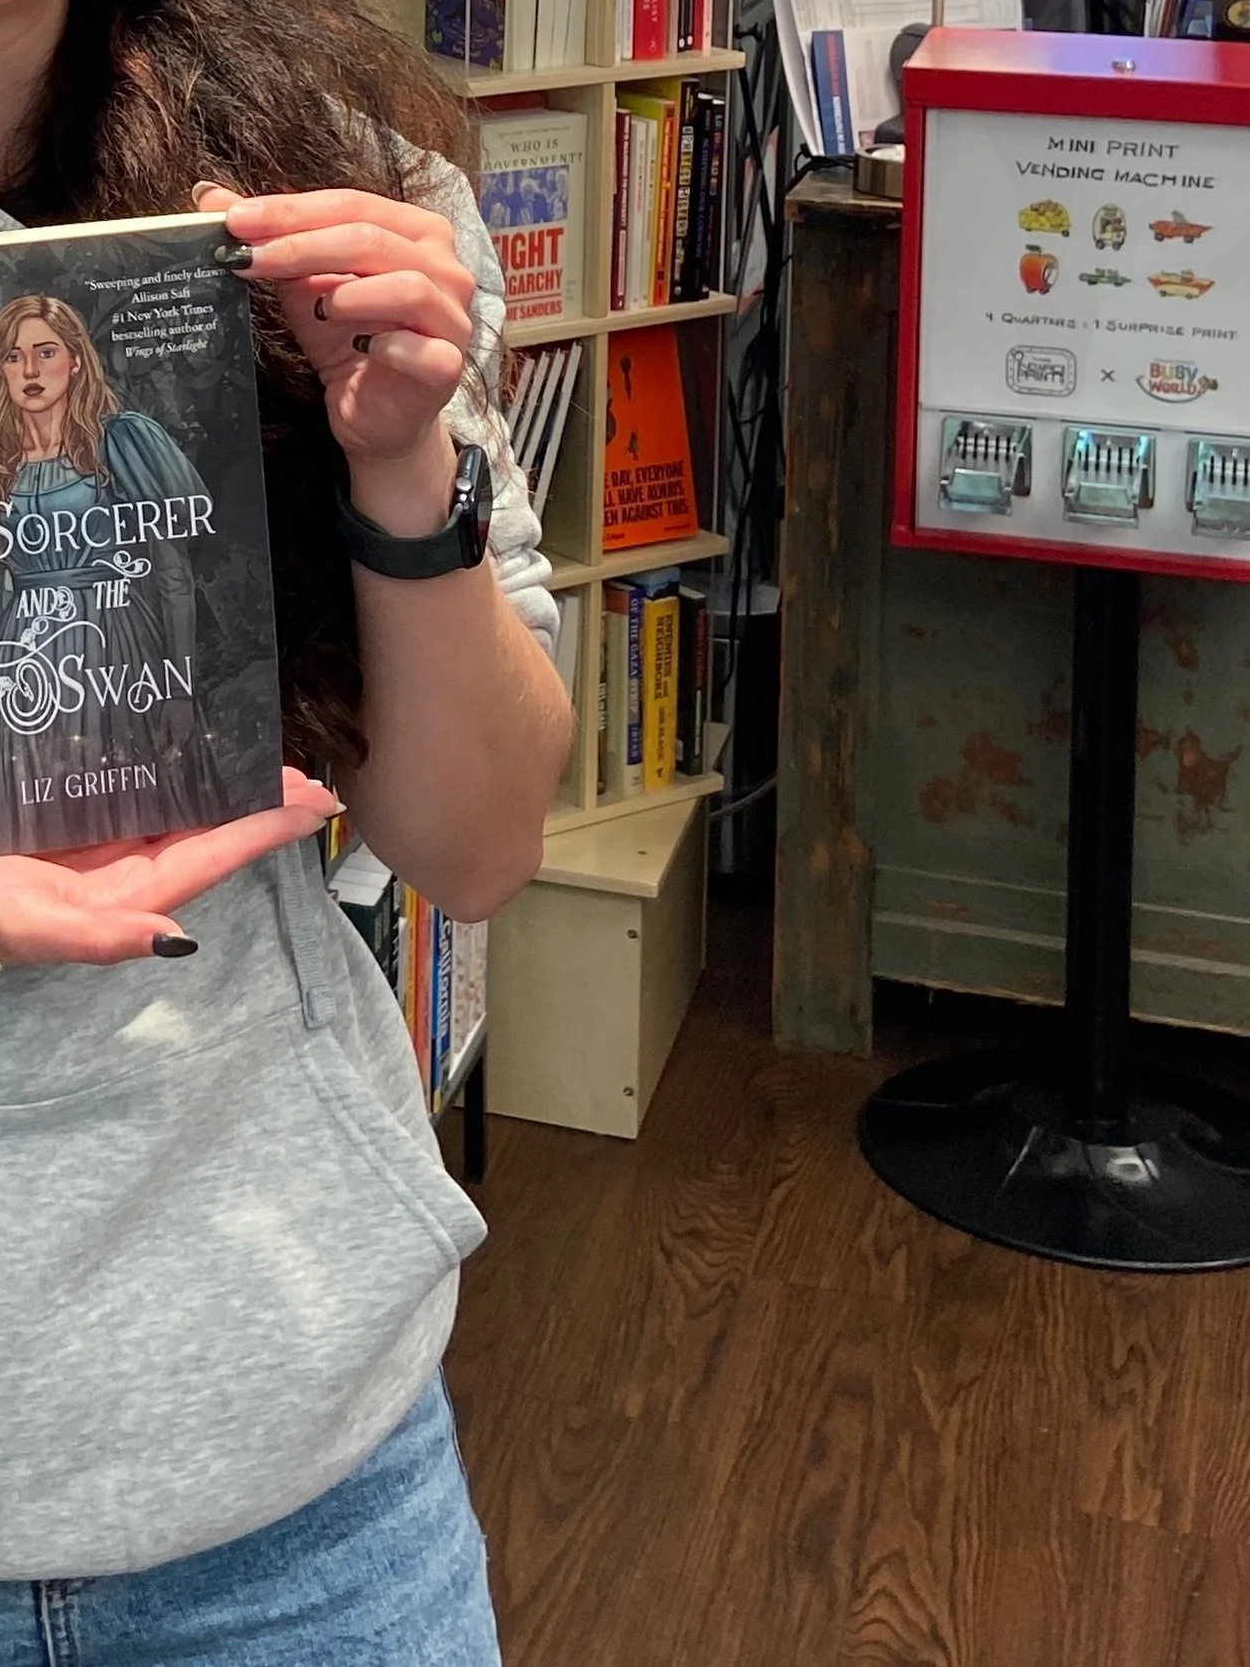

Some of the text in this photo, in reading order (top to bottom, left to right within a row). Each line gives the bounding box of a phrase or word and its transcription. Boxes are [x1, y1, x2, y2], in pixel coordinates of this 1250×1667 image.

[511, 139, 559, 153] WHO IS
[1047, 138, 1180, 159] MINI PRINT
[1016, 161, 1215, 189] VENDING MACHINE
[142, 272, 161, 285] and
[164, 269, 192, 282] finely
[131, 289, 169, 304] Allison
[112, 304, 214, 324] #1 New York Times
[519, 301, 563, 319] SANDERS
[111, 318, 218, 342] bestselling author of
[986, 312, 993, 321] 4
[1001, 312, 1075, 329] QUARTERS
[1105, 320, 1184, 336] SURPRISE
[1192, 327, 1237, 340] PRINT
[126, 338, 208, 358] Wings of Starlight
[1150, 363, 1198, 381] BUSY
[92, 579, 131, 609] THE
[21, 763, 158, 805] LIZ GRIFFIN
